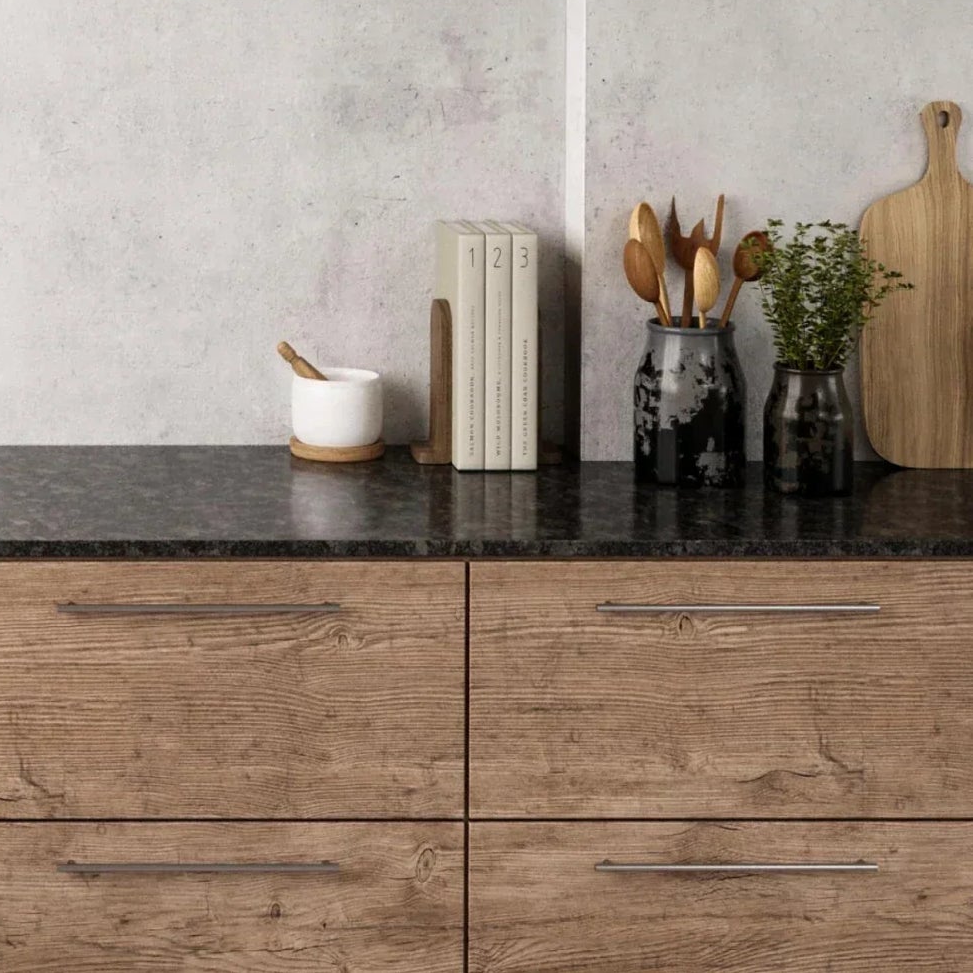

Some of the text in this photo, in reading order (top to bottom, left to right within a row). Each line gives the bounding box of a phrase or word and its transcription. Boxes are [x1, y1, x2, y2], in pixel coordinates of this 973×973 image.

[468, 247, 475, 268] 1
[493, 247, 502, 268] 2
[520, 246, 529, 268] 3
